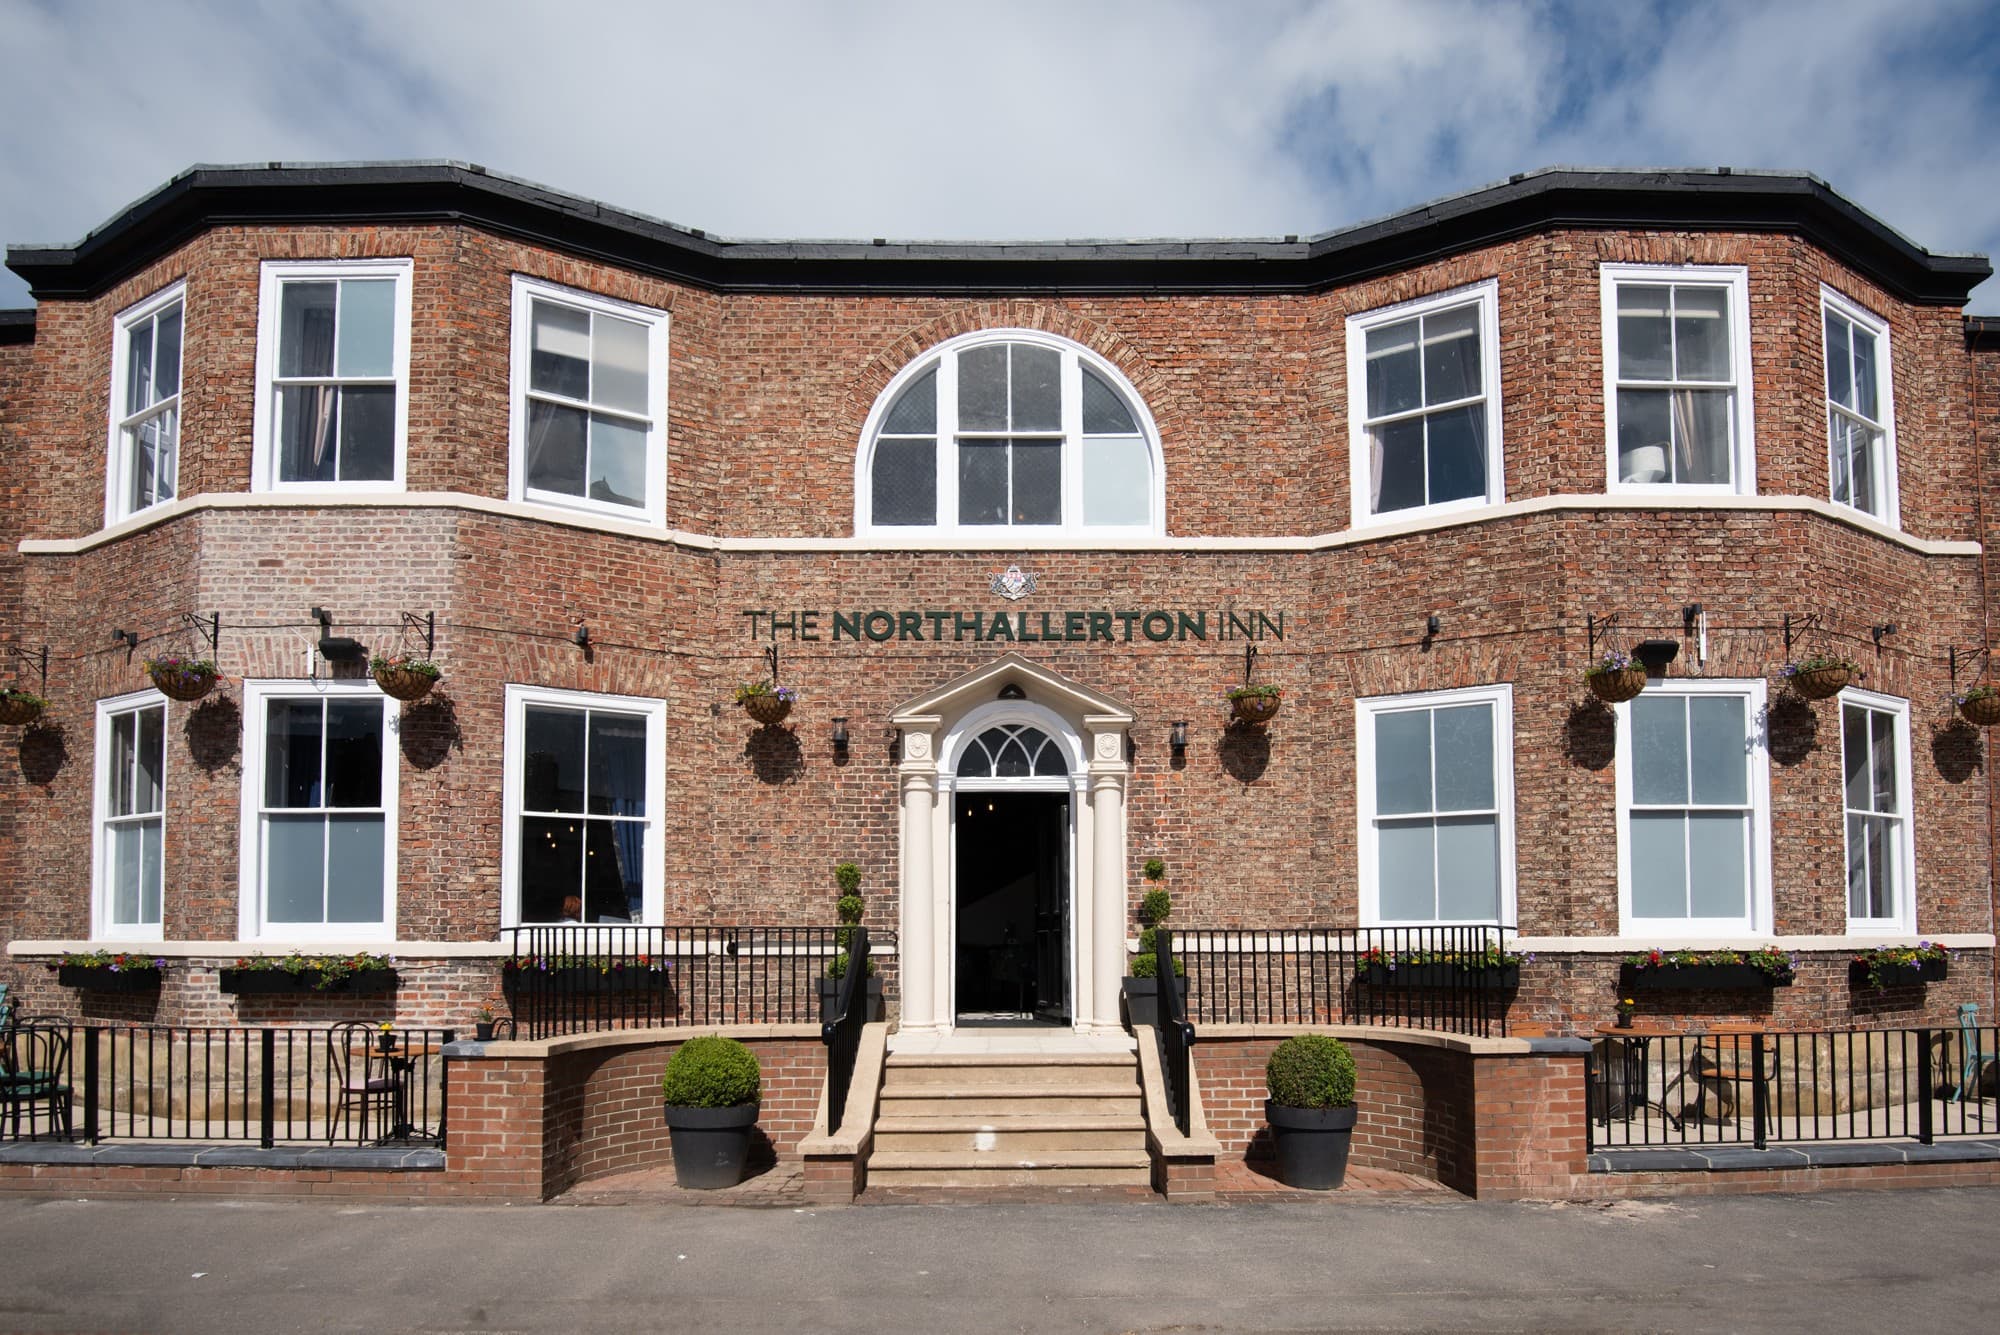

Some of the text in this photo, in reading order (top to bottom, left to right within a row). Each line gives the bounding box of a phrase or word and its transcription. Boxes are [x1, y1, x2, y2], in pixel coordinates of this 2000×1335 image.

[742, 610, 1284, 642] THE NORTHALLERTON INN
